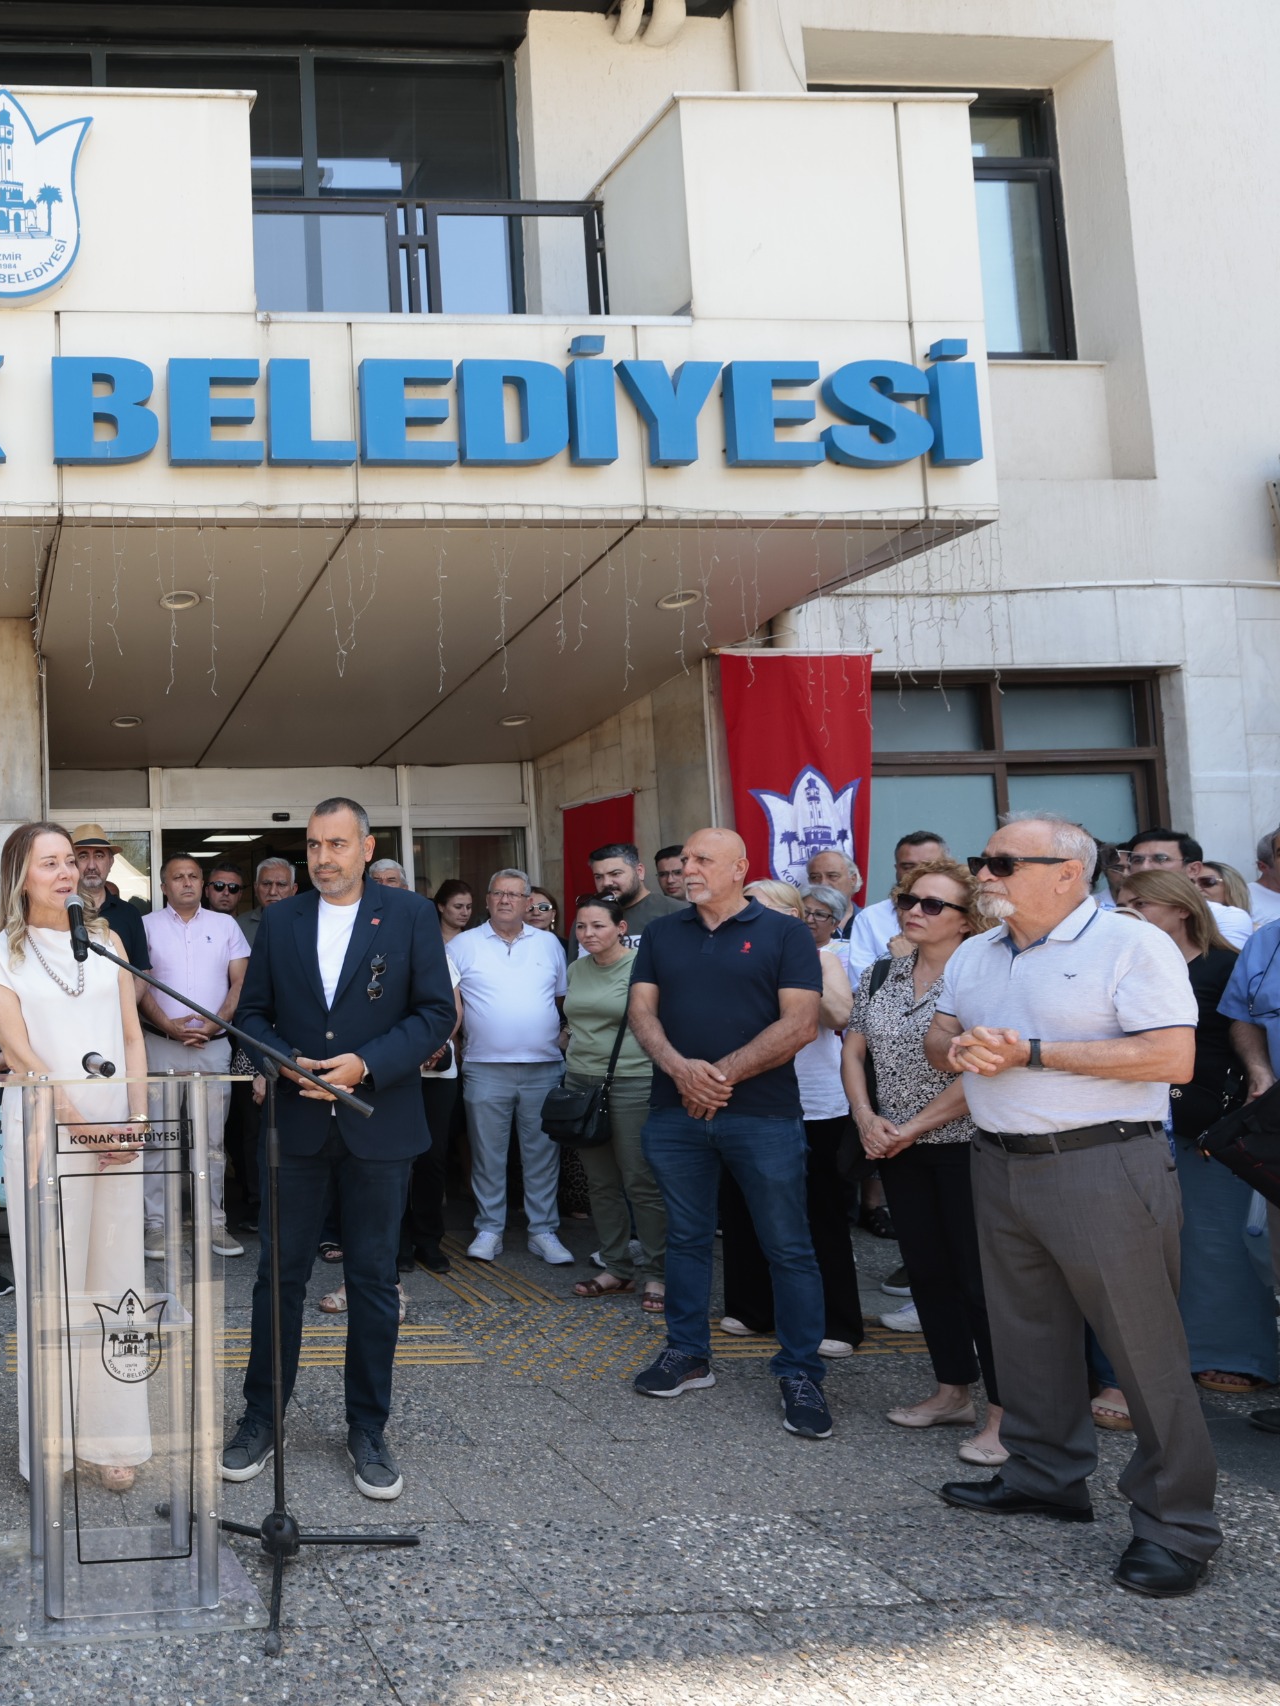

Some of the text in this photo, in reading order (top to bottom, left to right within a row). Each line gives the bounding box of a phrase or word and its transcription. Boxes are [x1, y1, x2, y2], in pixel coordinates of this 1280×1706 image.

[51, 335, 983, 469] BELEDİYESİ
[70, 1128, 181, 1145] KONAK BELEDİYESİ
